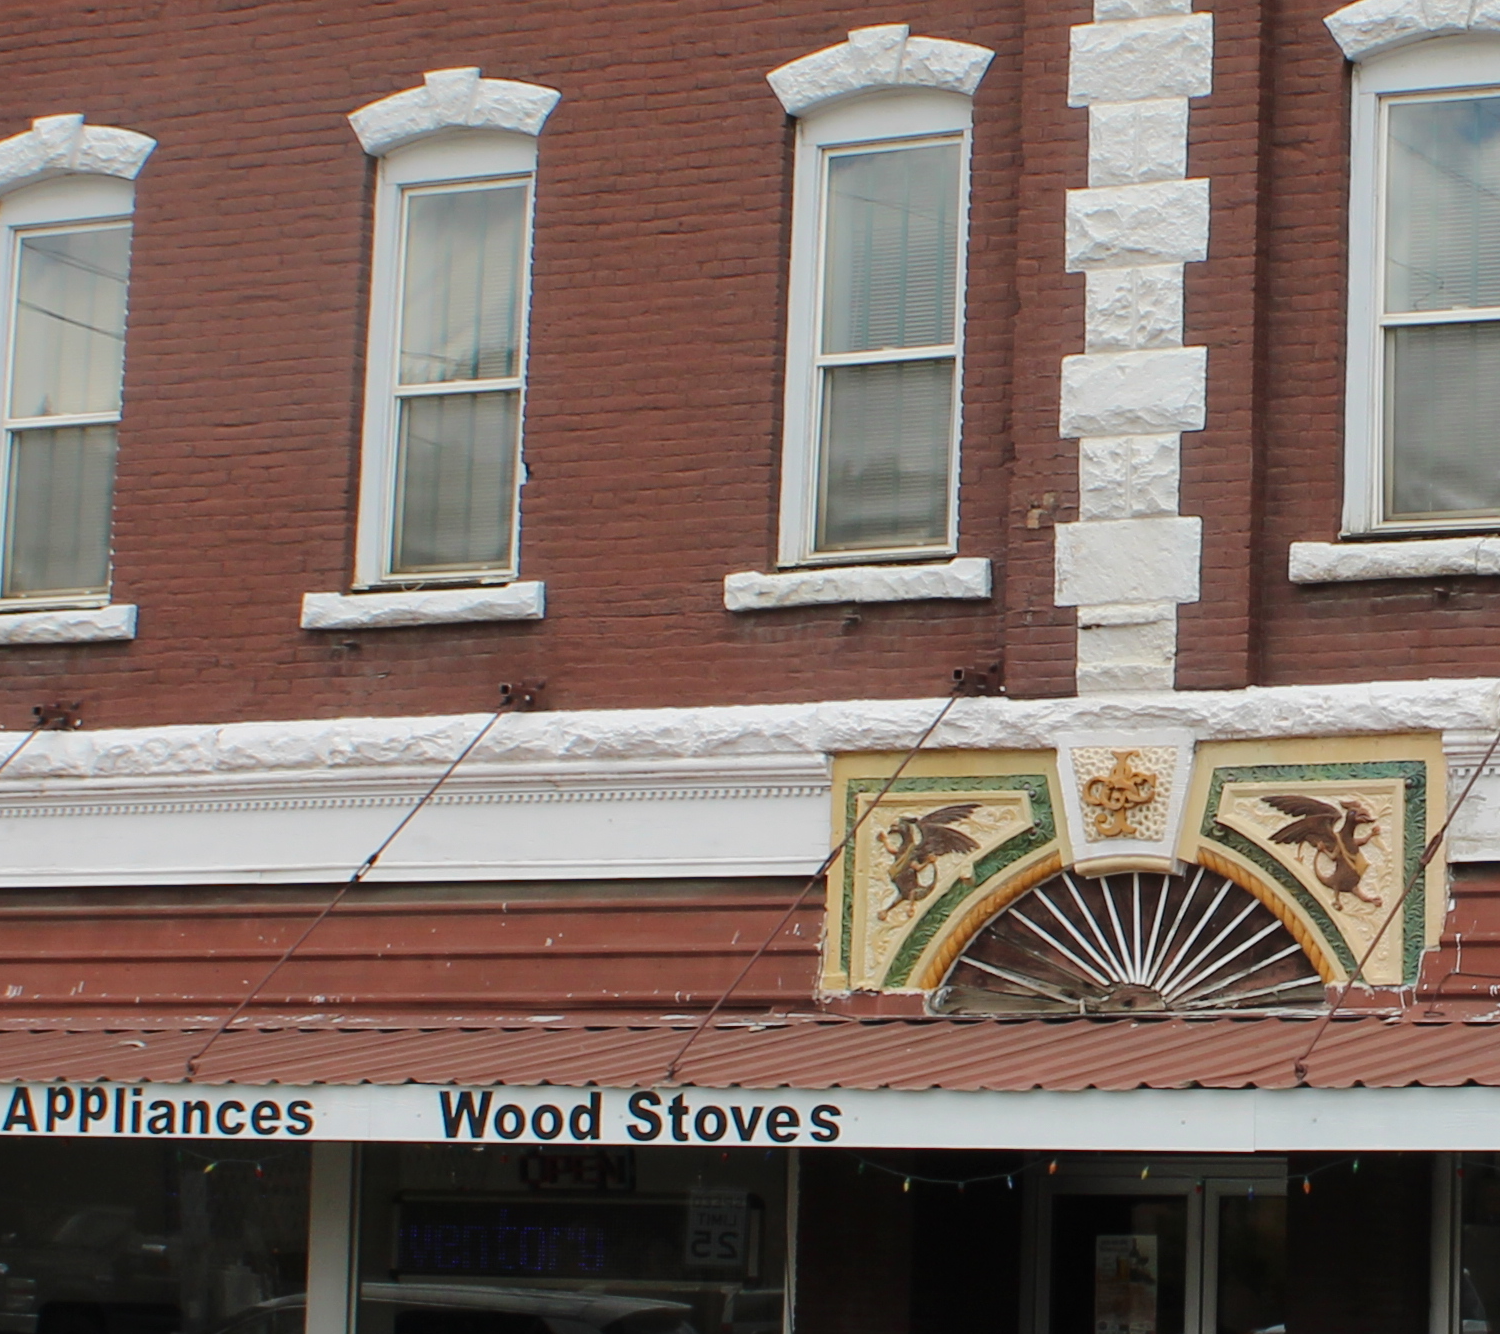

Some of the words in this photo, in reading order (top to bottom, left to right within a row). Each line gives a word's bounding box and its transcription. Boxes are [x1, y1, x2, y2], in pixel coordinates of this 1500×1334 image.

[2, 1085, 315, 1136] Appliances
[439, 1090, 602, 1141] Wood
[626, 1090, 843, 1142] Stoves
[518, 1153, 626, 1185] OPEN
